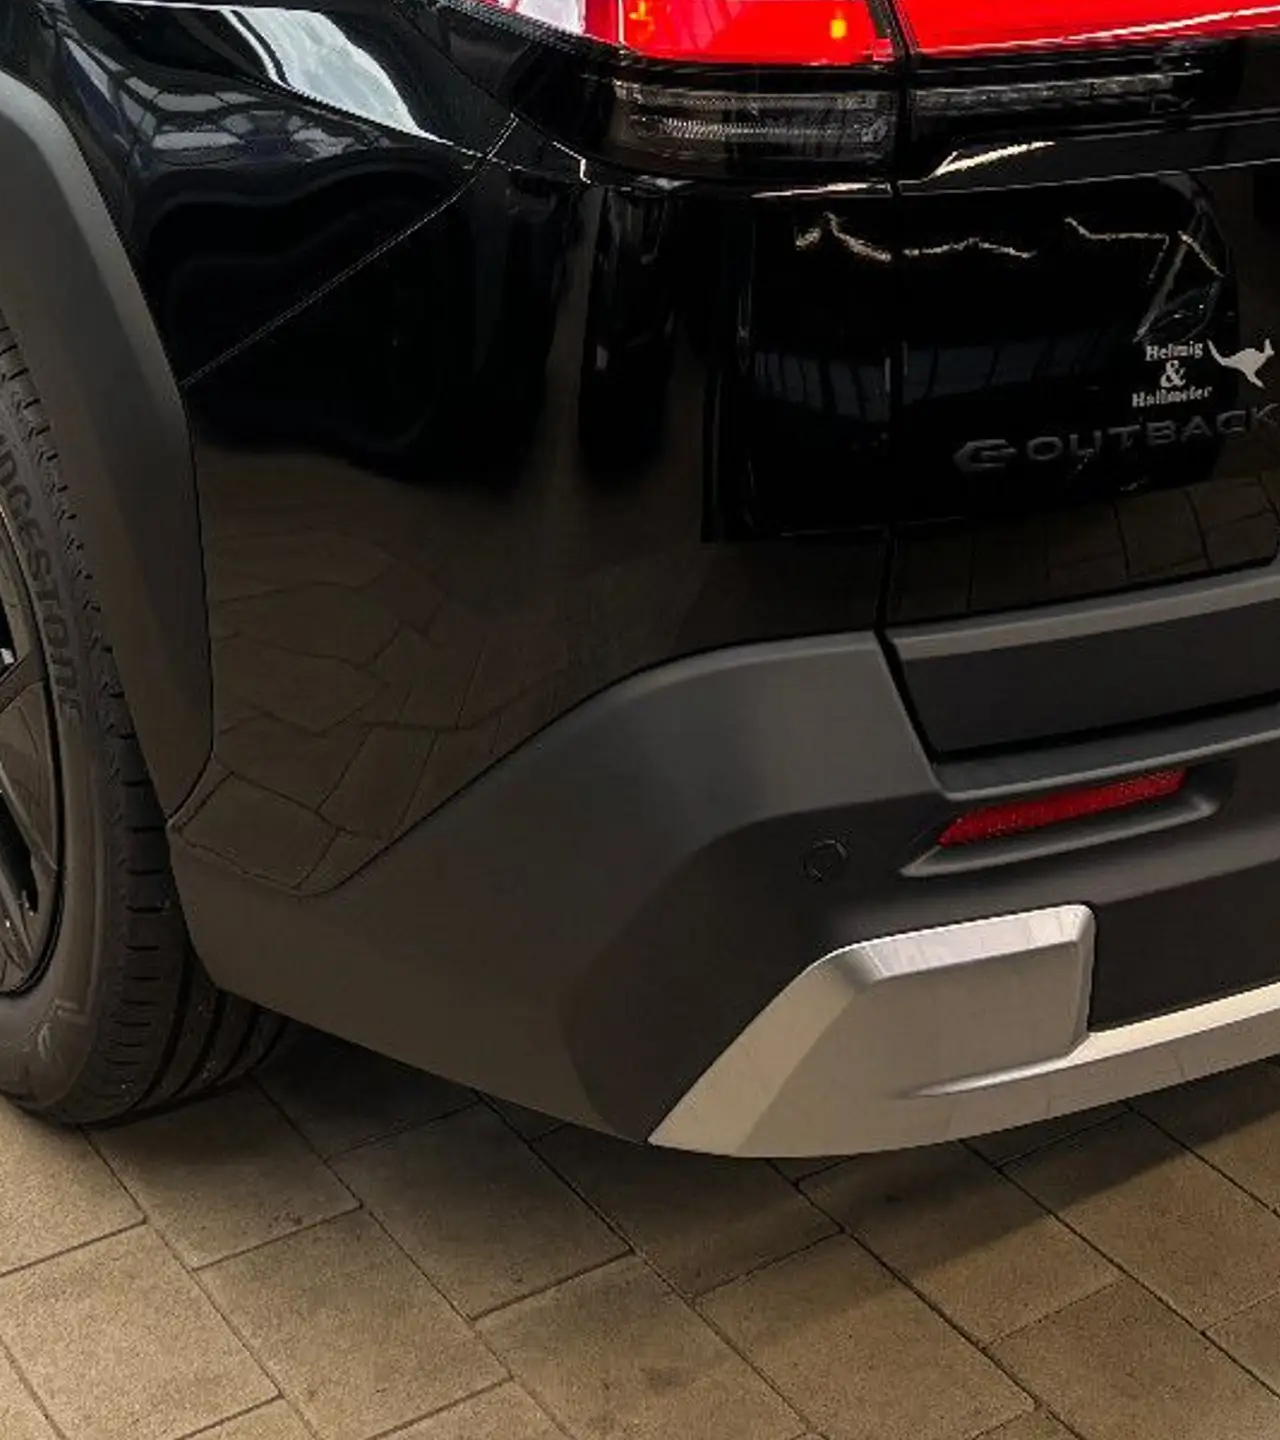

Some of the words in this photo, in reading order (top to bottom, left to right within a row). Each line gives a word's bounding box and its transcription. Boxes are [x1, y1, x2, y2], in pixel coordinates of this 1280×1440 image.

[1145, 340, 1204, 361] Helmig
[1160, 360, 1186, 388] &
[1131, 386, 1213, 408] Hallmeier
